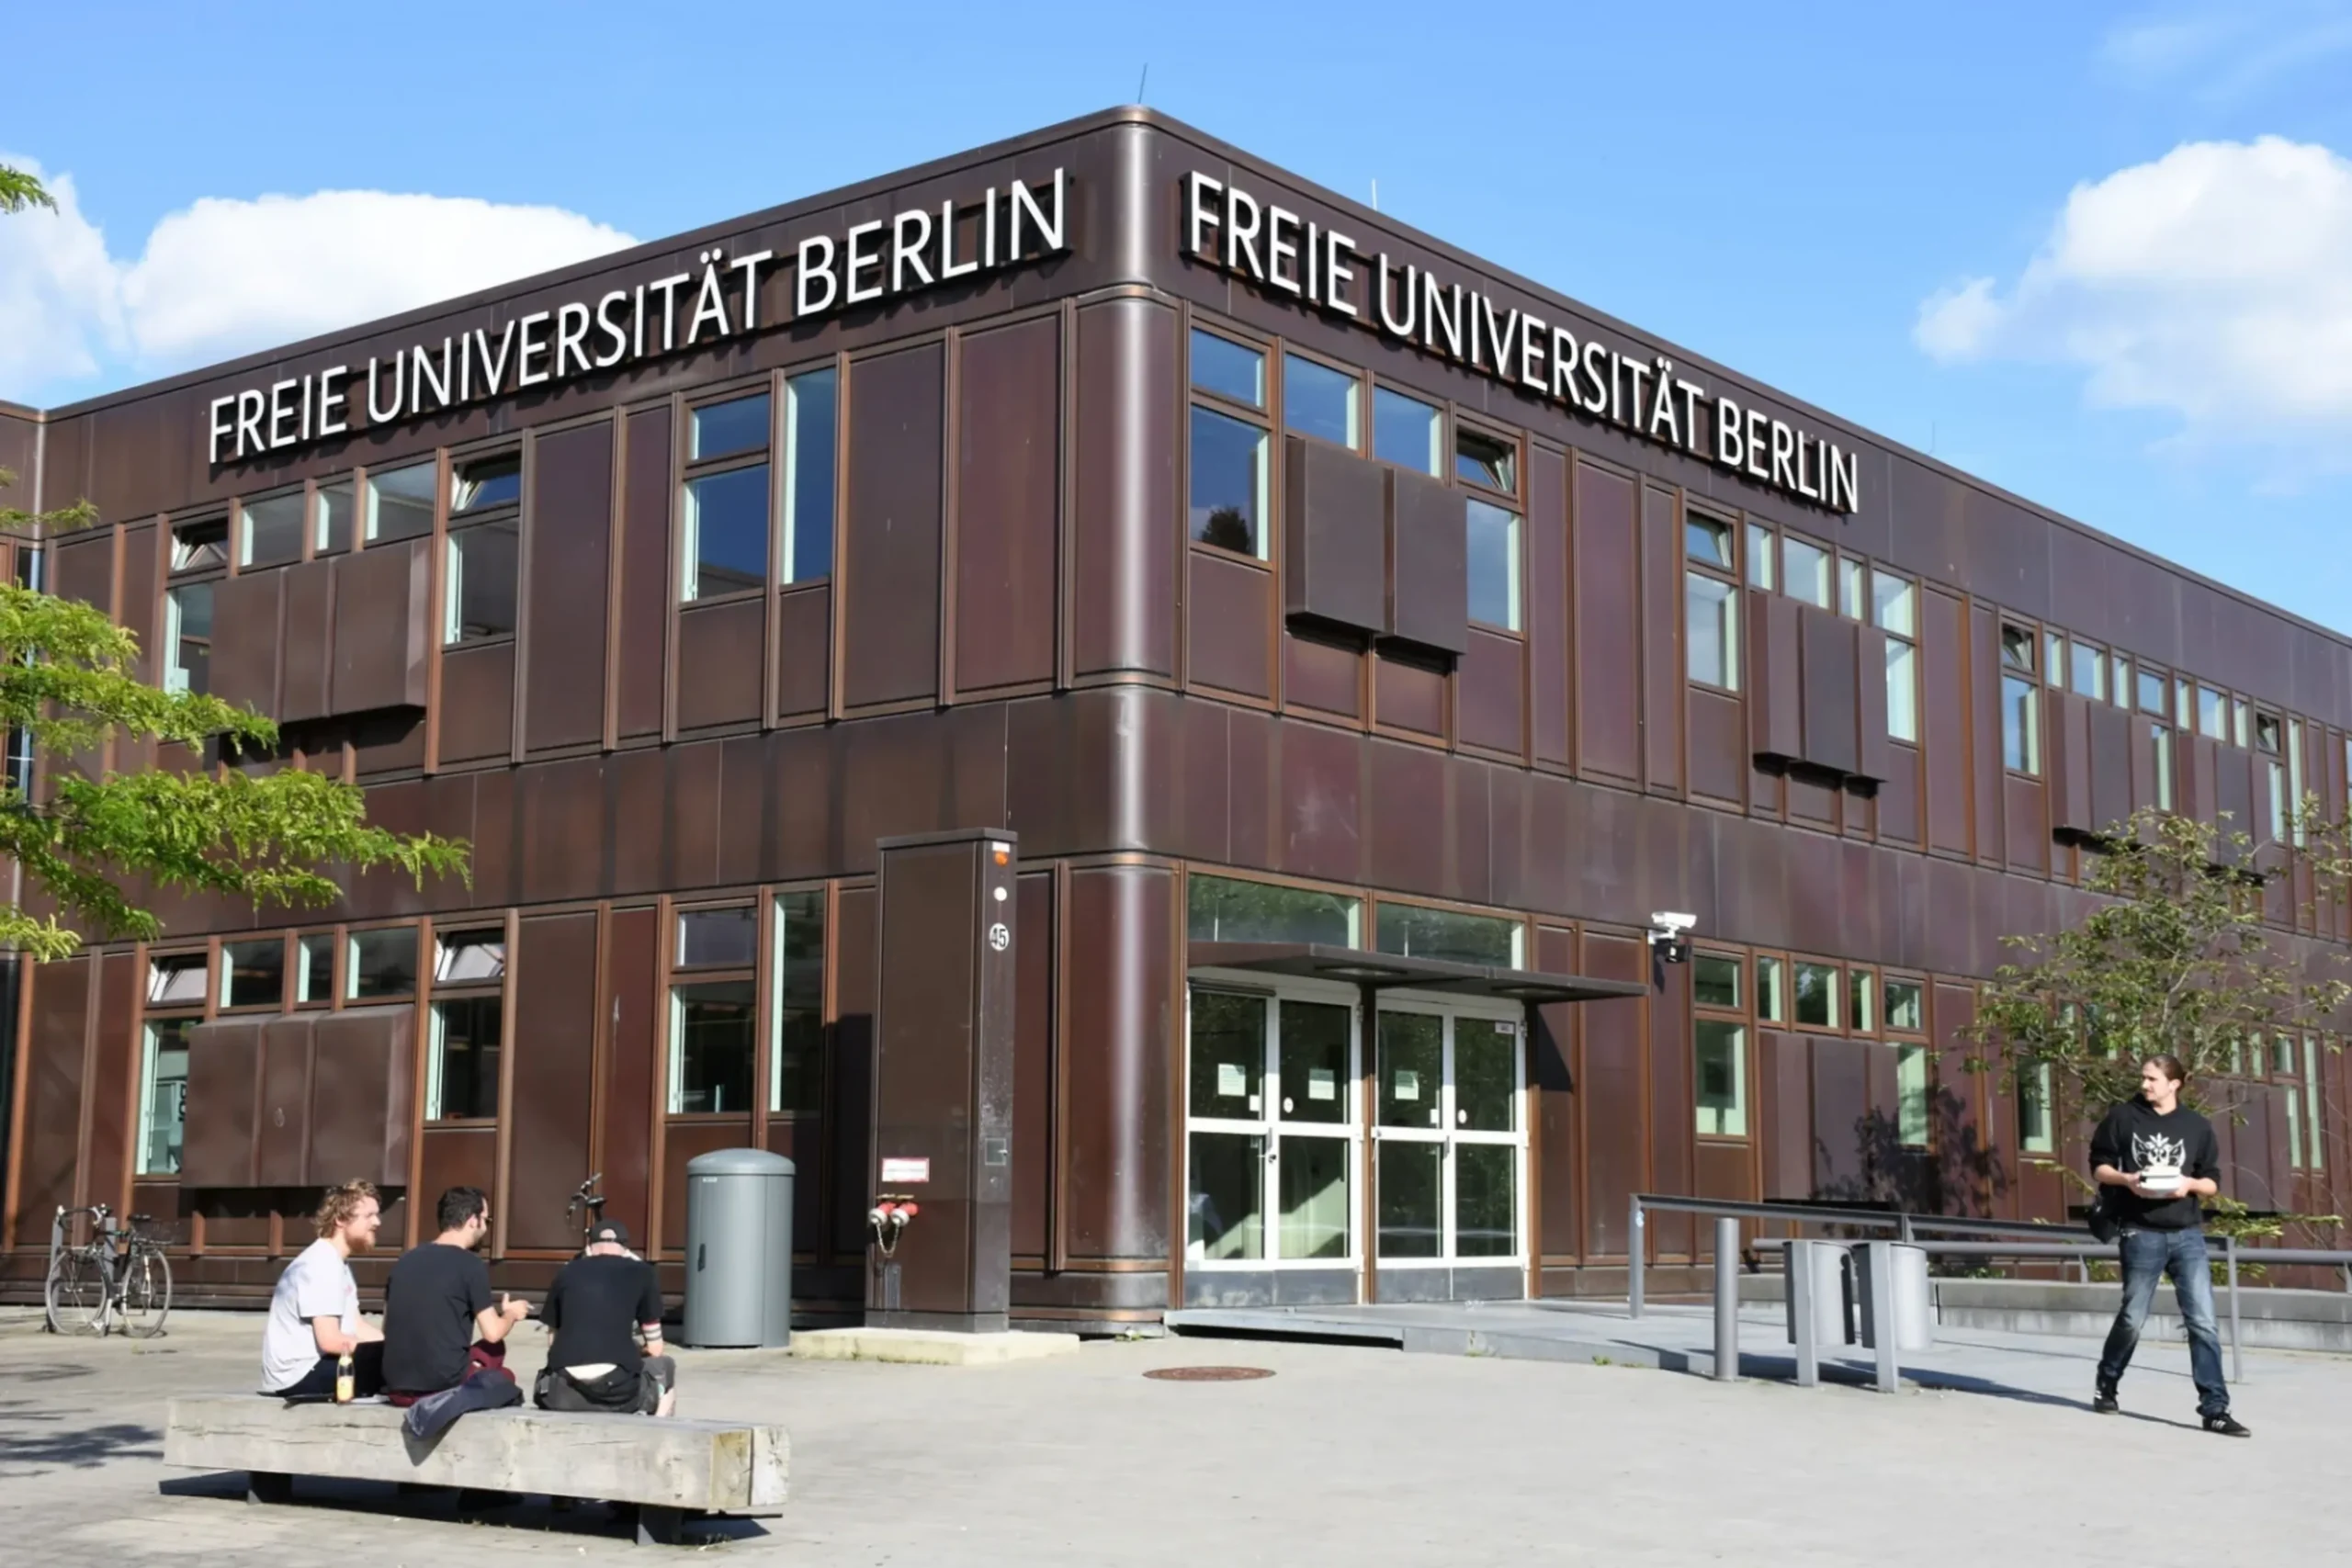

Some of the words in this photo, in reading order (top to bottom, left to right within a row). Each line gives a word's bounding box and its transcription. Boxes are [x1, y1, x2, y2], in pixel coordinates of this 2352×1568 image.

[209, 365, 347, 463] FREIE
[368, 248, 774, 425] UNIVERSITÄT
[797, 167, 1063, 316] BERLIN
[1192, 170, 1357, 316] FREIE
[1380, 253, 1703, 450] UNIVERSITÄT
[1719, 397, 1858, 513] BERLIN
[991, 927, 1007, 946] 45
